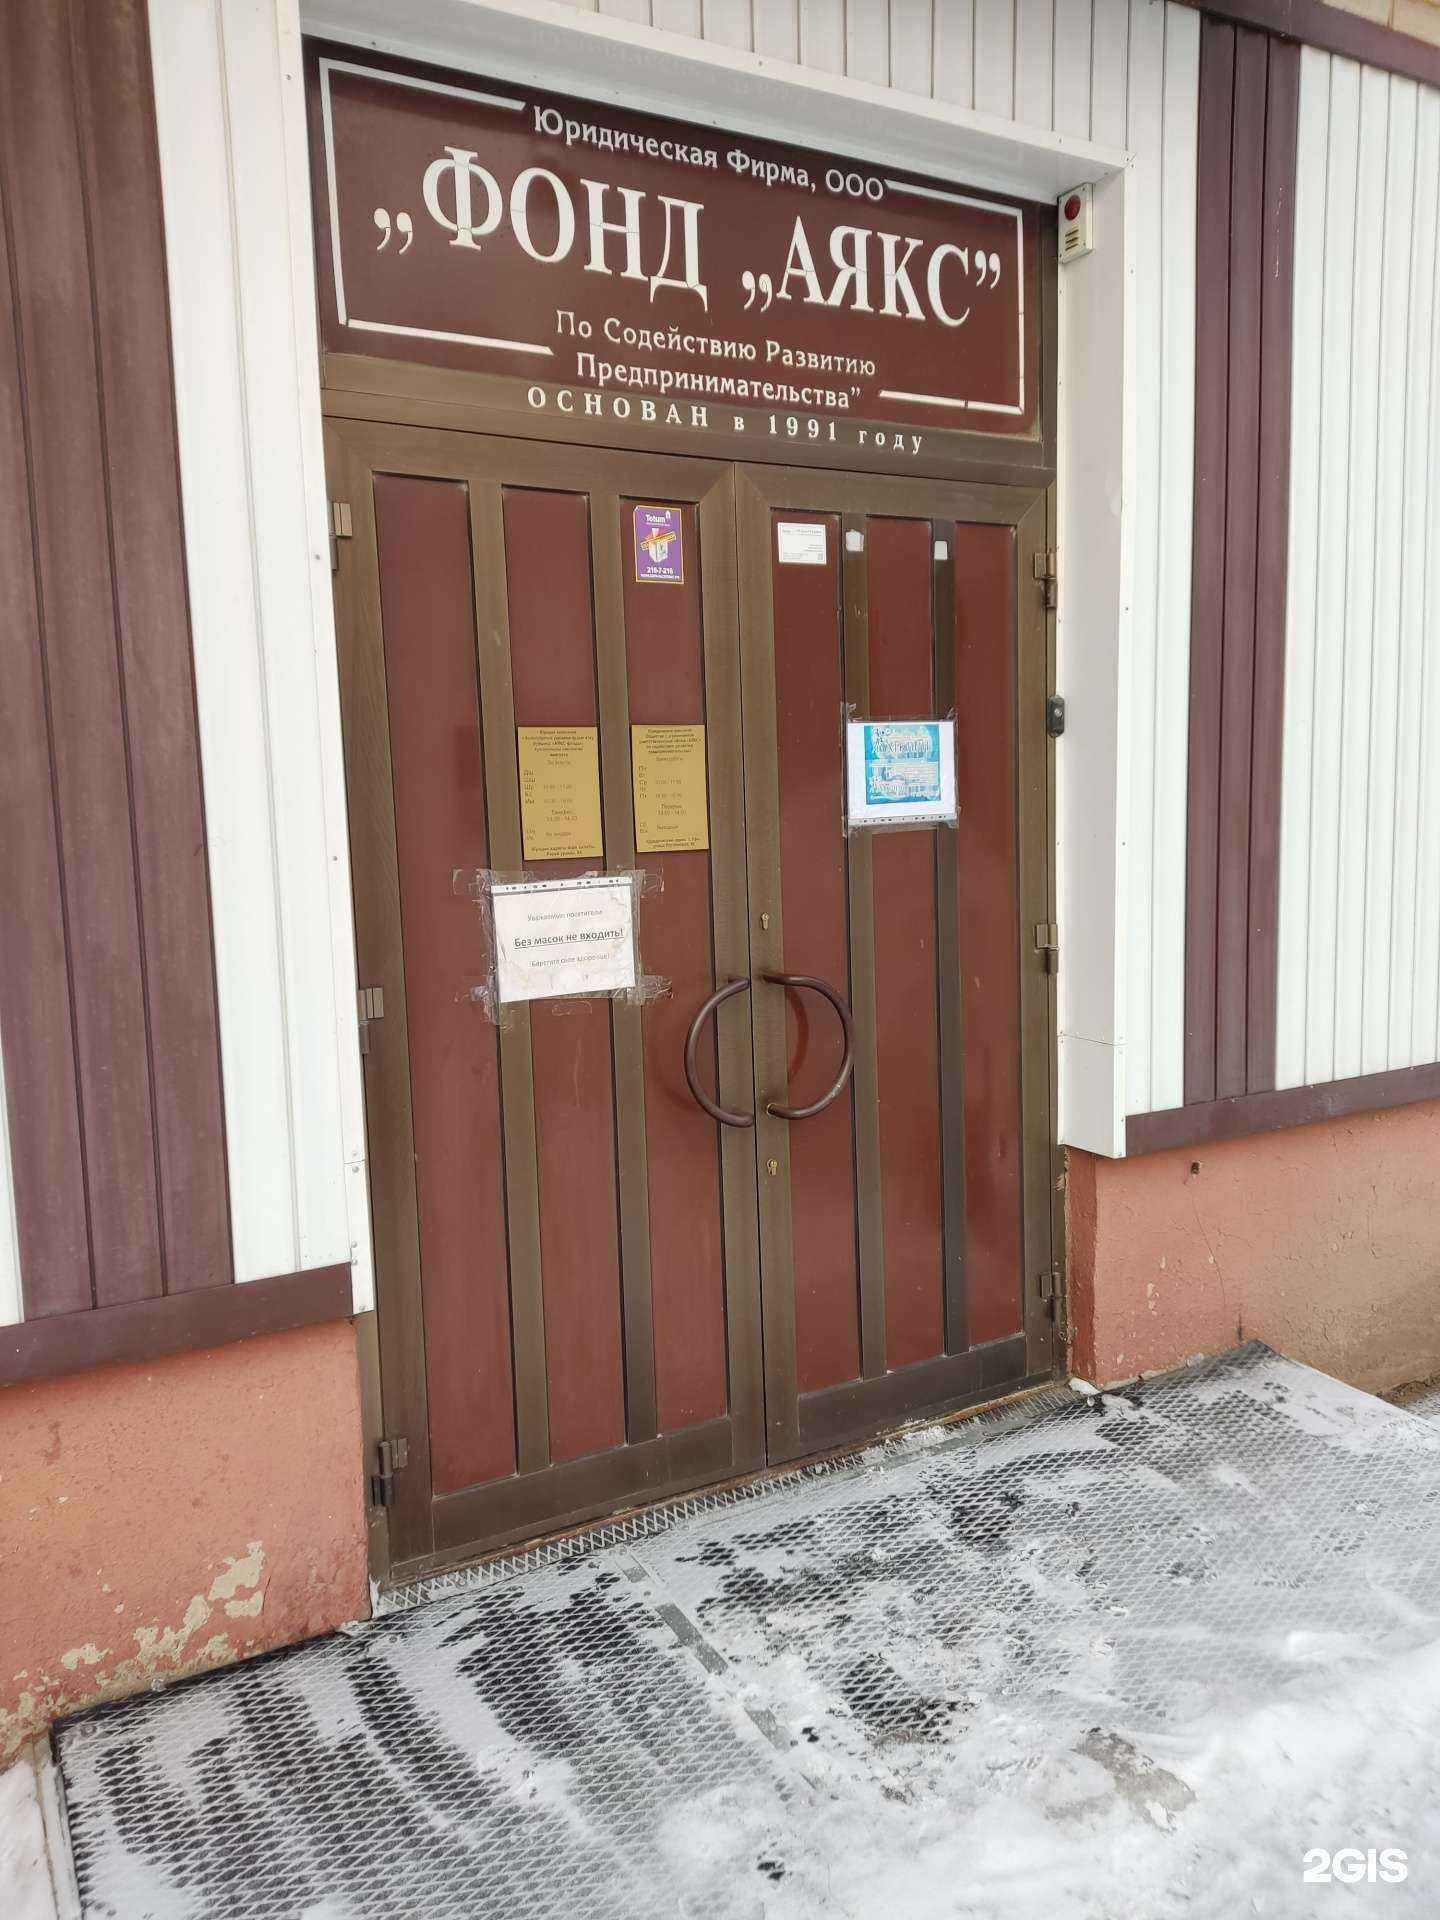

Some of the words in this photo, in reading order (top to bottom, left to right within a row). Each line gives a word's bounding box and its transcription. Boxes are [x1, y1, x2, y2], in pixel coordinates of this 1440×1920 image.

[533, 104, 719, 169] Юридическая
[726, 148, 817, 194] Фирма,
[825, 168, 885, 201] ООО
[556, 309, 593, 338] По
[603, 317, 757, 361] Содействию
[765, 339, 876, 377] Развитию
[527, 385, 709, 429] ОСНОВАН
[733, 415, 746, 432] в
[767, 413, 839, 442] 1991
[858, 426, 924, 455] году
[514, 937, 532, 948] Без
[534, 935, 564, 946] масок
[566, 933, 578, 942] не
[580, 928, 624, 941] входить!
